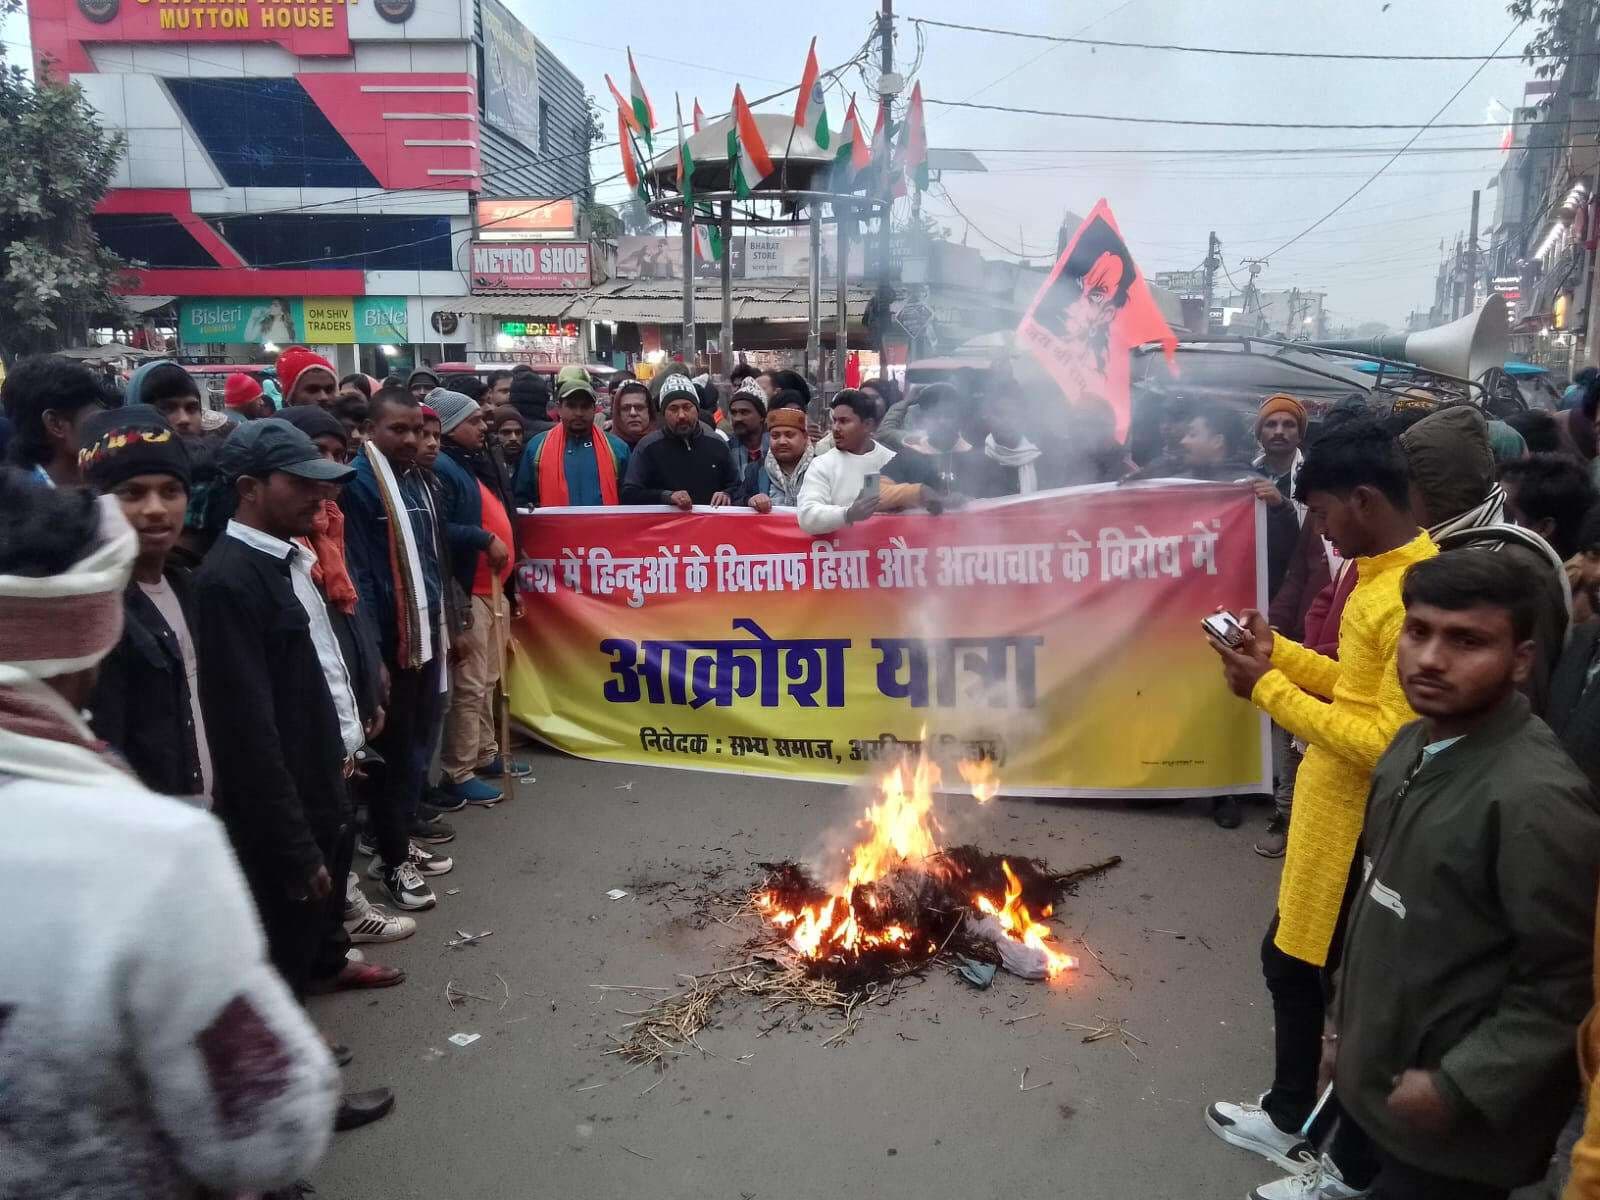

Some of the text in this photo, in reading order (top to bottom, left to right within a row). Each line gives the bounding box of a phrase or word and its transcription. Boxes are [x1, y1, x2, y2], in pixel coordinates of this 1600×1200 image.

[159, 7, 335, 29] MUTTON HOUSE
[750, 241, 780, 250] BHARAT
[752, 251, 777, 260] STORE
[473, 247, 587, 273] METRO SHOE
[191, 304, 242, 326] Bisleri
[309, 309, 348, 318] OM SHIV
[308, 321, 351, 331] TRADERS
[559, 547, 584, 594] में
[588, 546, 681, 608] हिन्दुओं
[683, 545, 709, 593] के
[714, 543, 806, 593] खिलाफ
[809, 541, 870, 590] हिंसा
[876, 537, 928, 588] और
[935, 543, 1058, 586] अत्याचार
[1057, 529, 1092, 583] के
[1097, 525, 1184, 581] विरोध
[1187, 518, 1221, 575] में
[600, 618, 1044, 710] आक्रोश यात्रा
[639, 726, 709, 755] निवेदक
[728, 736, 769, 757] सभ्य
[773, 737, 842, 764] समाज,
